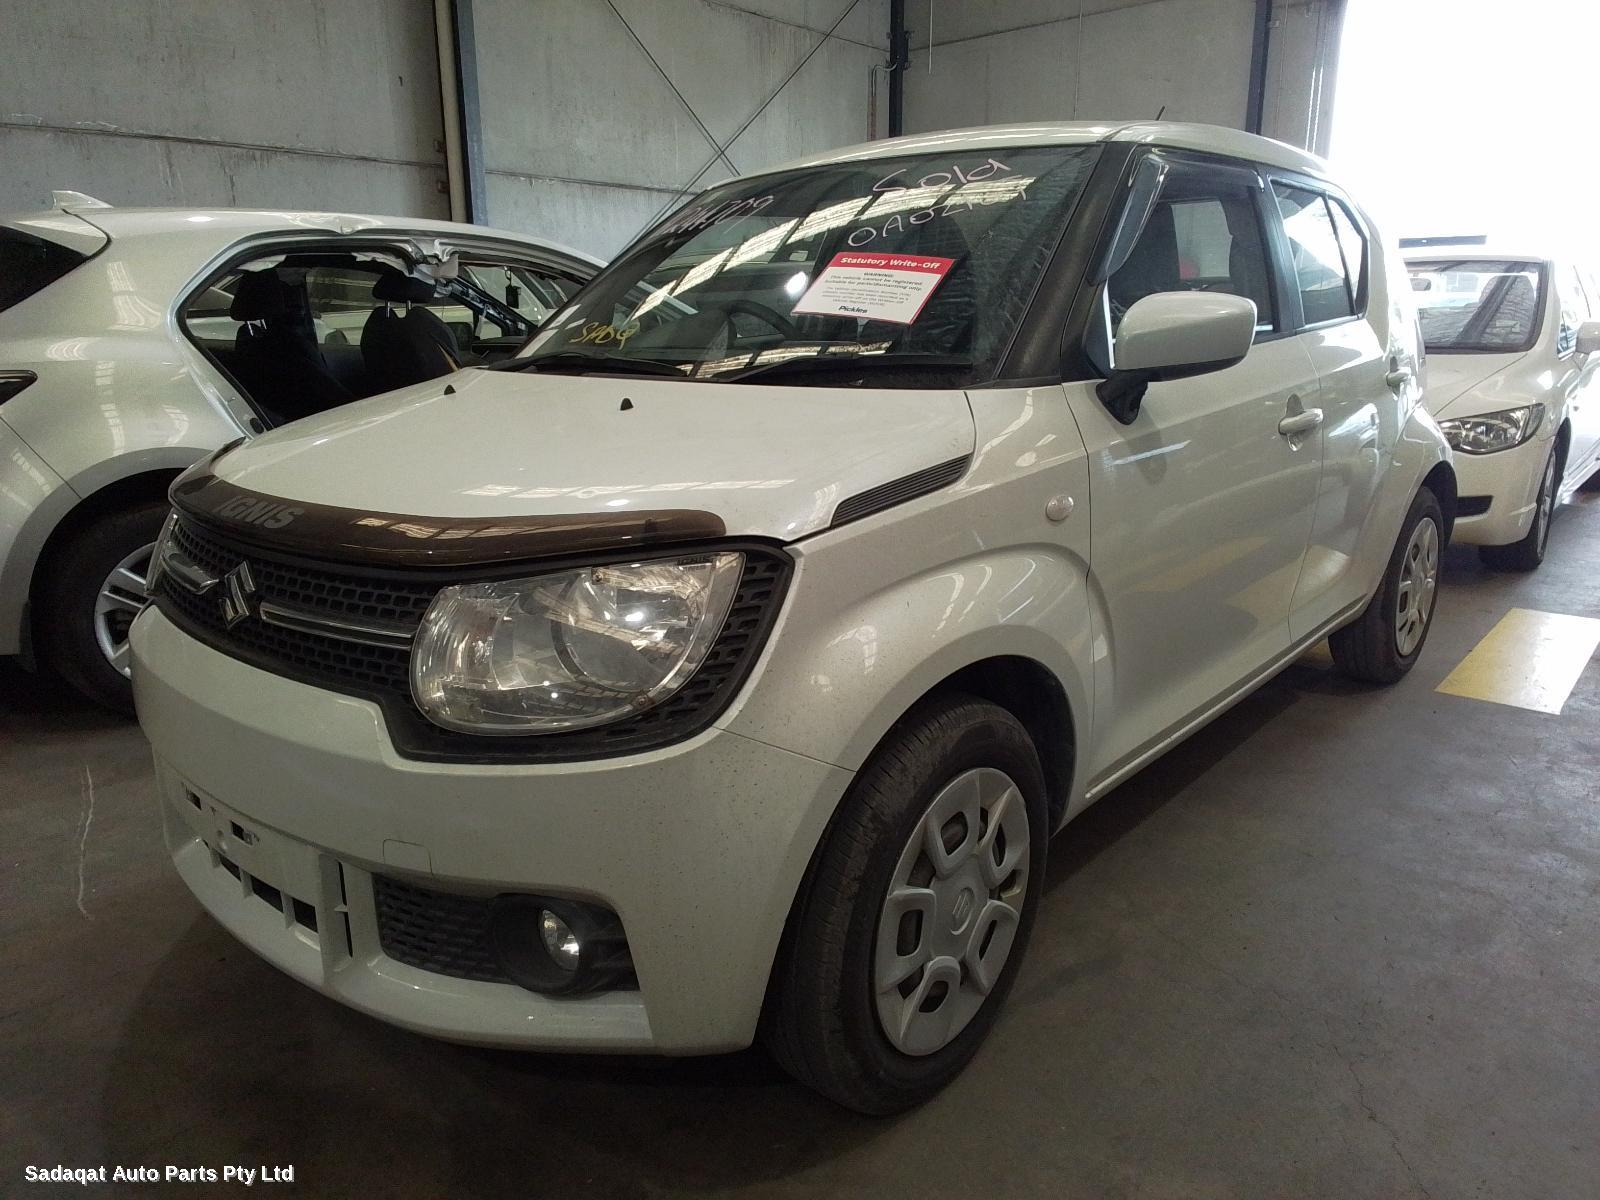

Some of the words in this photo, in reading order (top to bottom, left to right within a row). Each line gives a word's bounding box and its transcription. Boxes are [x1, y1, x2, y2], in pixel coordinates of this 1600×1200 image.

[840, 257, 888, 266] Statutory
[890, 259, 941, 269] Write-Off
[838, 305, 868, 314] Pickles
[213, 495, 305, 529] IGNIS
